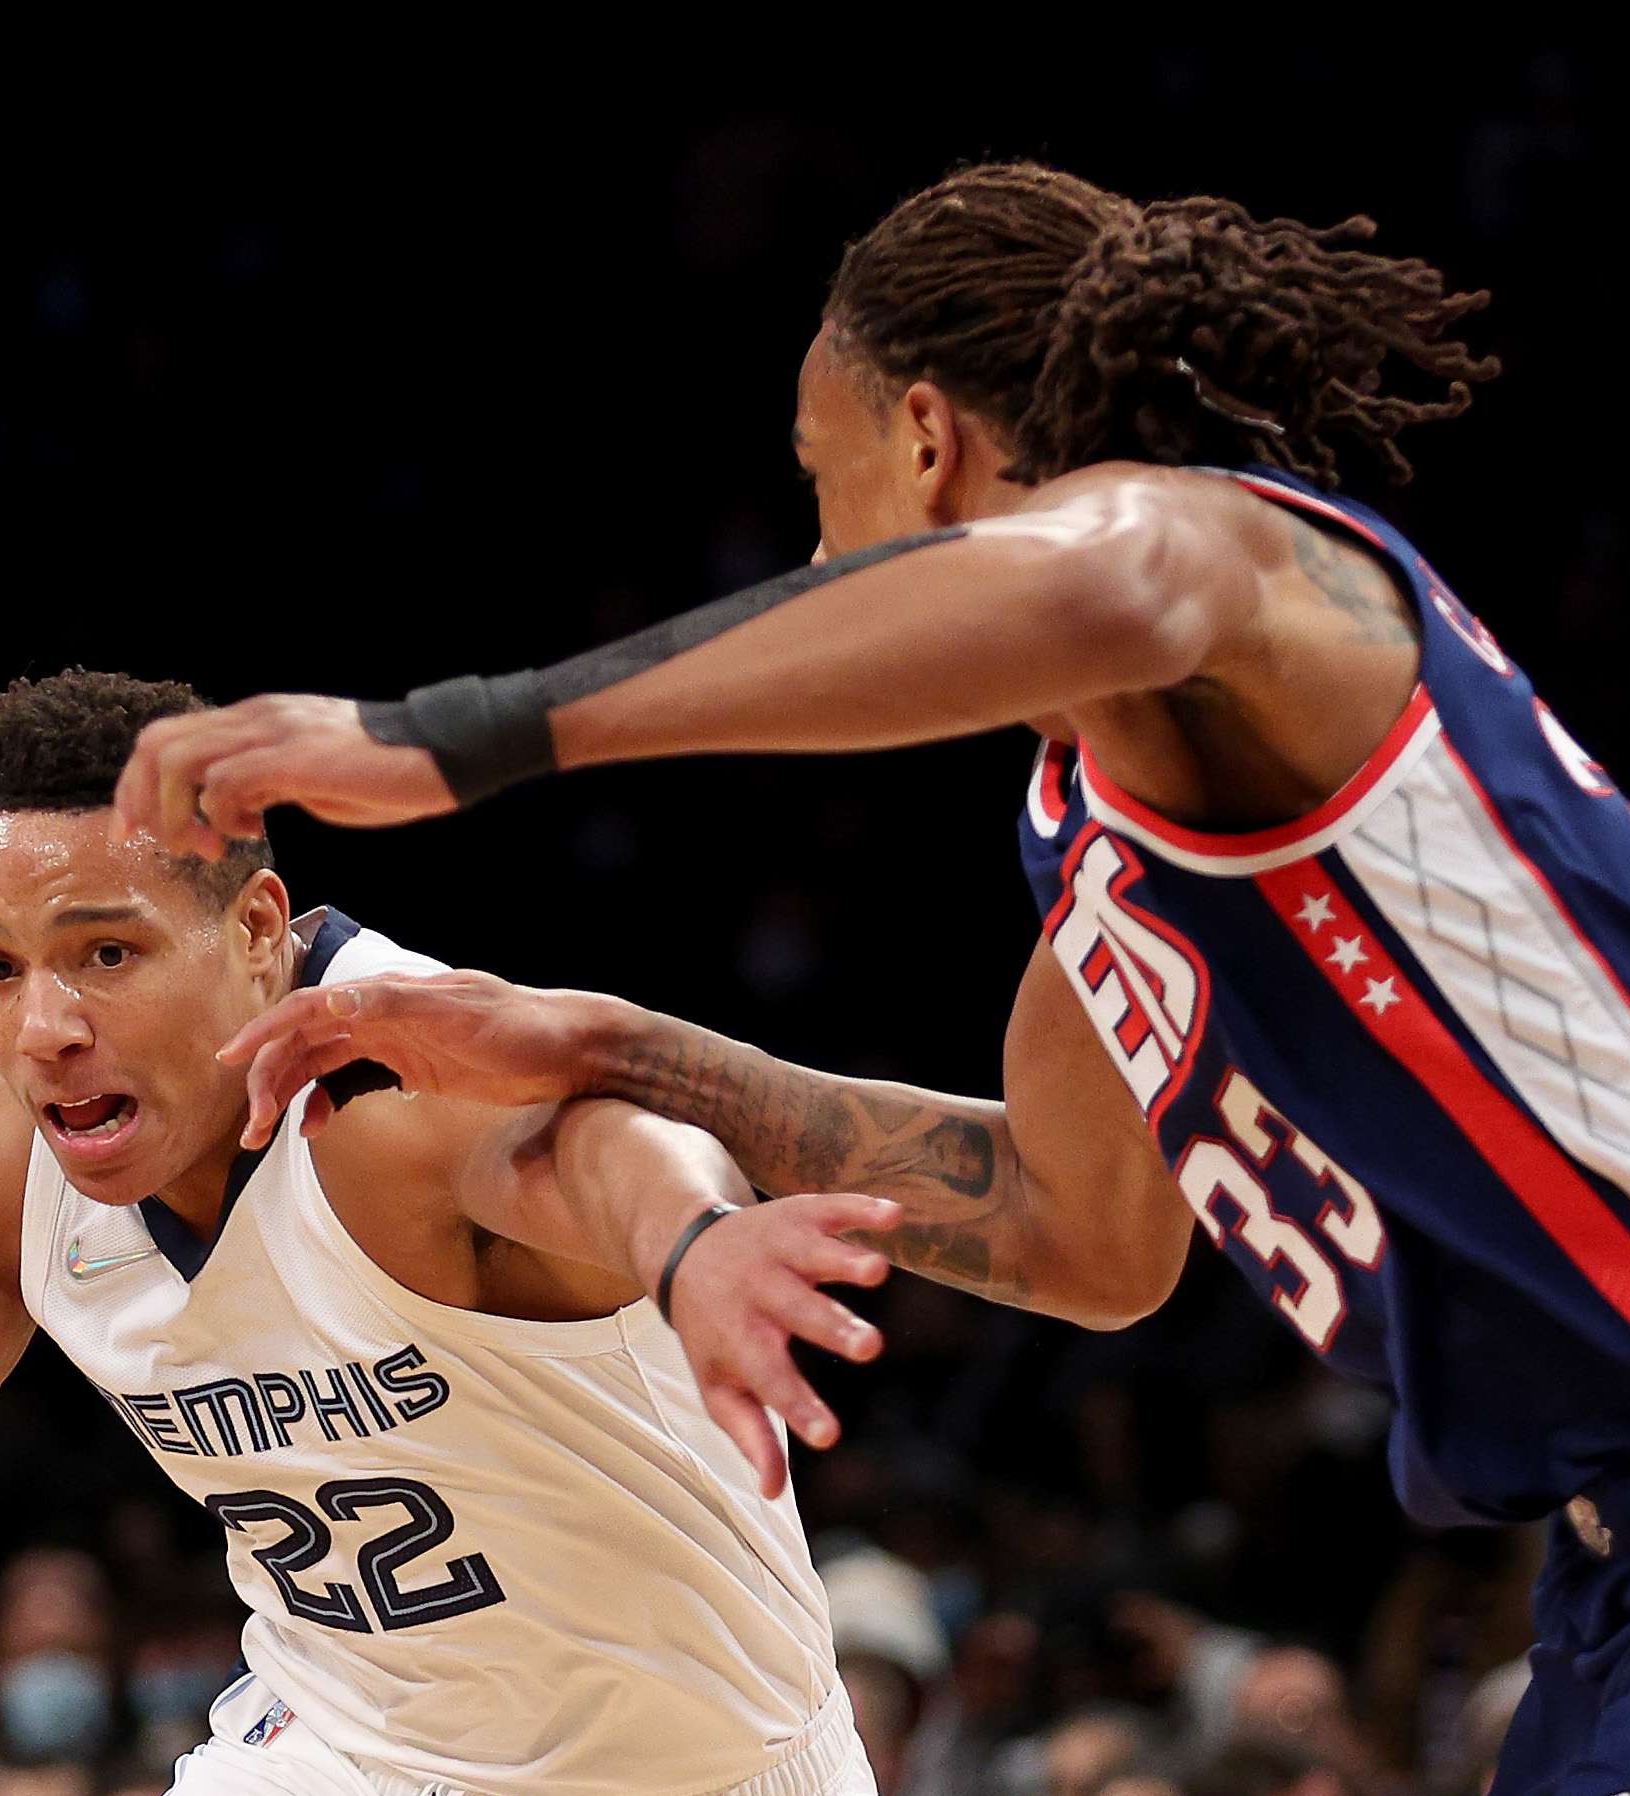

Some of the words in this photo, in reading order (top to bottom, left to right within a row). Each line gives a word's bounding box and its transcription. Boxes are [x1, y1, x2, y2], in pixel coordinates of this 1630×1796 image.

[1173, 1064, 1388, 1353] 33
[95, 1342, 450, 1457] EMPHIS
[204, 1475, 507, 1634] 22
